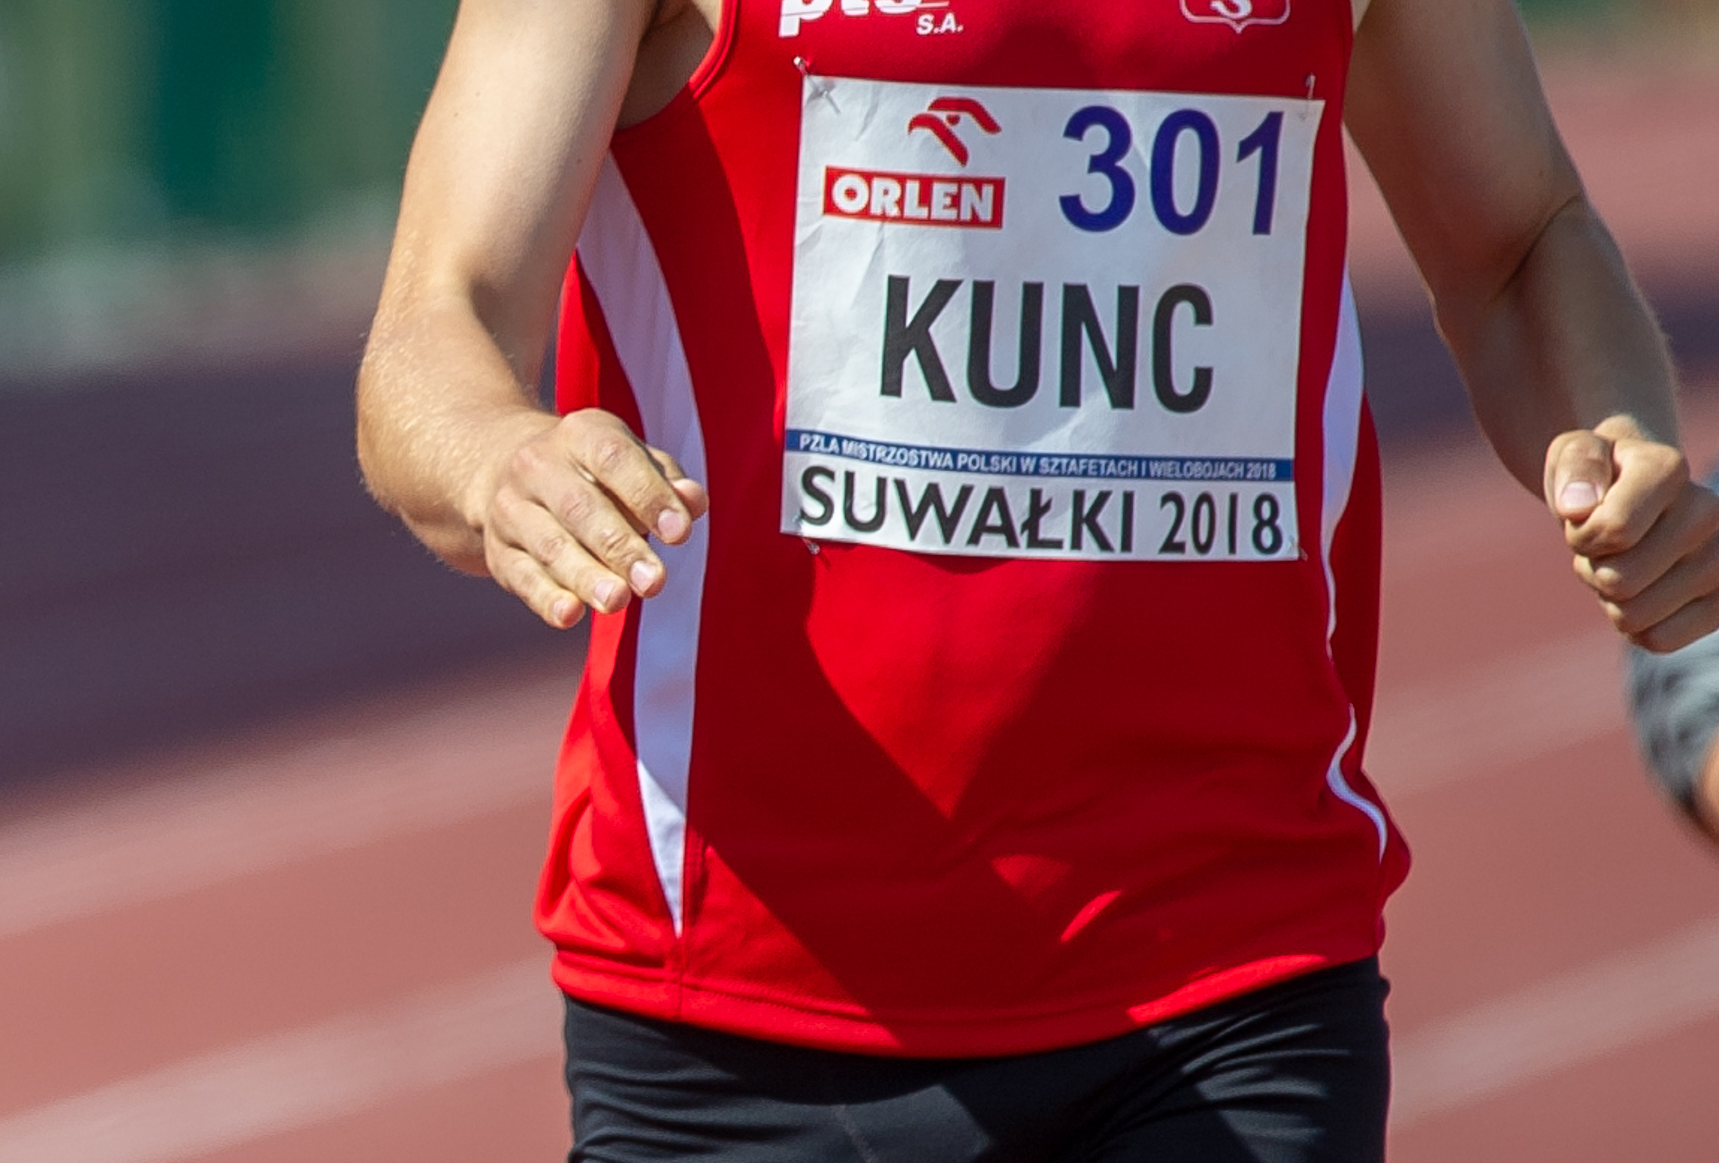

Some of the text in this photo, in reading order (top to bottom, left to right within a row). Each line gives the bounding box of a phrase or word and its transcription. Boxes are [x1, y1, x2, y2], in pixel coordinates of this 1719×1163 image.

[916, 12, 964, 36] S.A.
[831, 173, 995, 223] ORLEN
[1058, 105, 1284, 236] 301
[879, 274, 1214, 414] KUNC
[799, 433, 839, 454] PZLA
[842, 440, 953, 469] MISTRZOSTWA
[957, 453, 1017, 473] POLSKI
[1020, 456, 1037, 474] W
[1038, 456, 1138, 477] SZTAFETACH
[1148, 459, 1245, 479] WIELOBOJACH
[1245, 462, 1277, 480] 2018
[800, 465, 1284, 555] SUWAŁKI 2018
